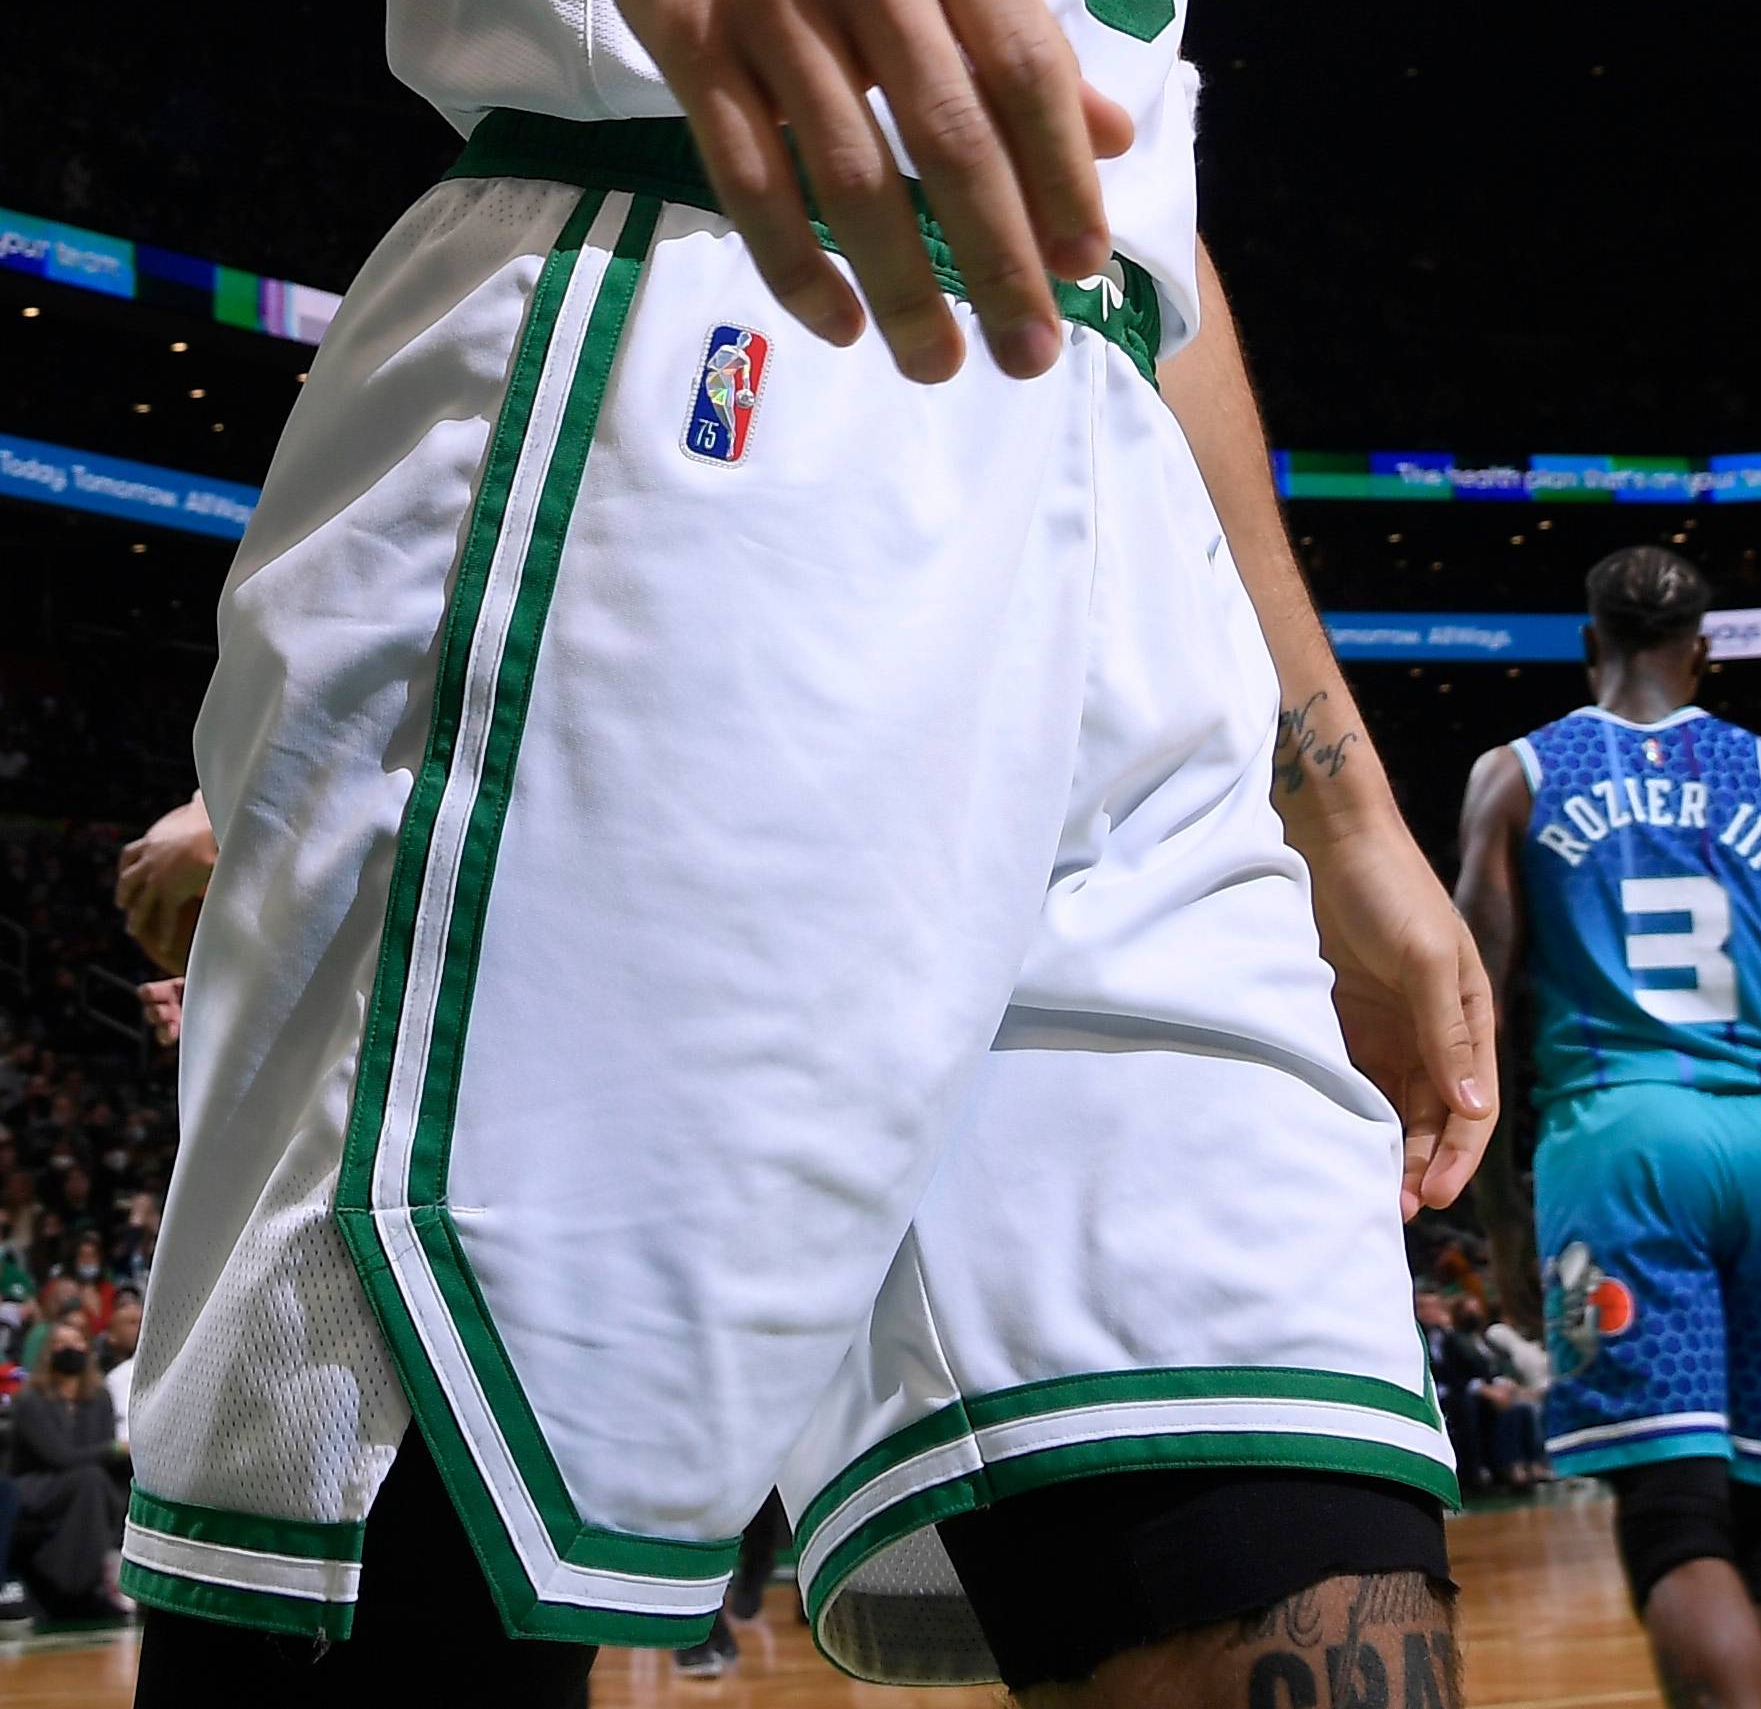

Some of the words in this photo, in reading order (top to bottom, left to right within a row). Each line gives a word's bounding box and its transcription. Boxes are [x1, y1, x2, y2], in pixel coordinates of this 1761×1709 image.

[695, 418, 717, 451] 75
[1539, 777, 1709, 869] ROZIER
[1620, 874, 1739, 1023] 3
